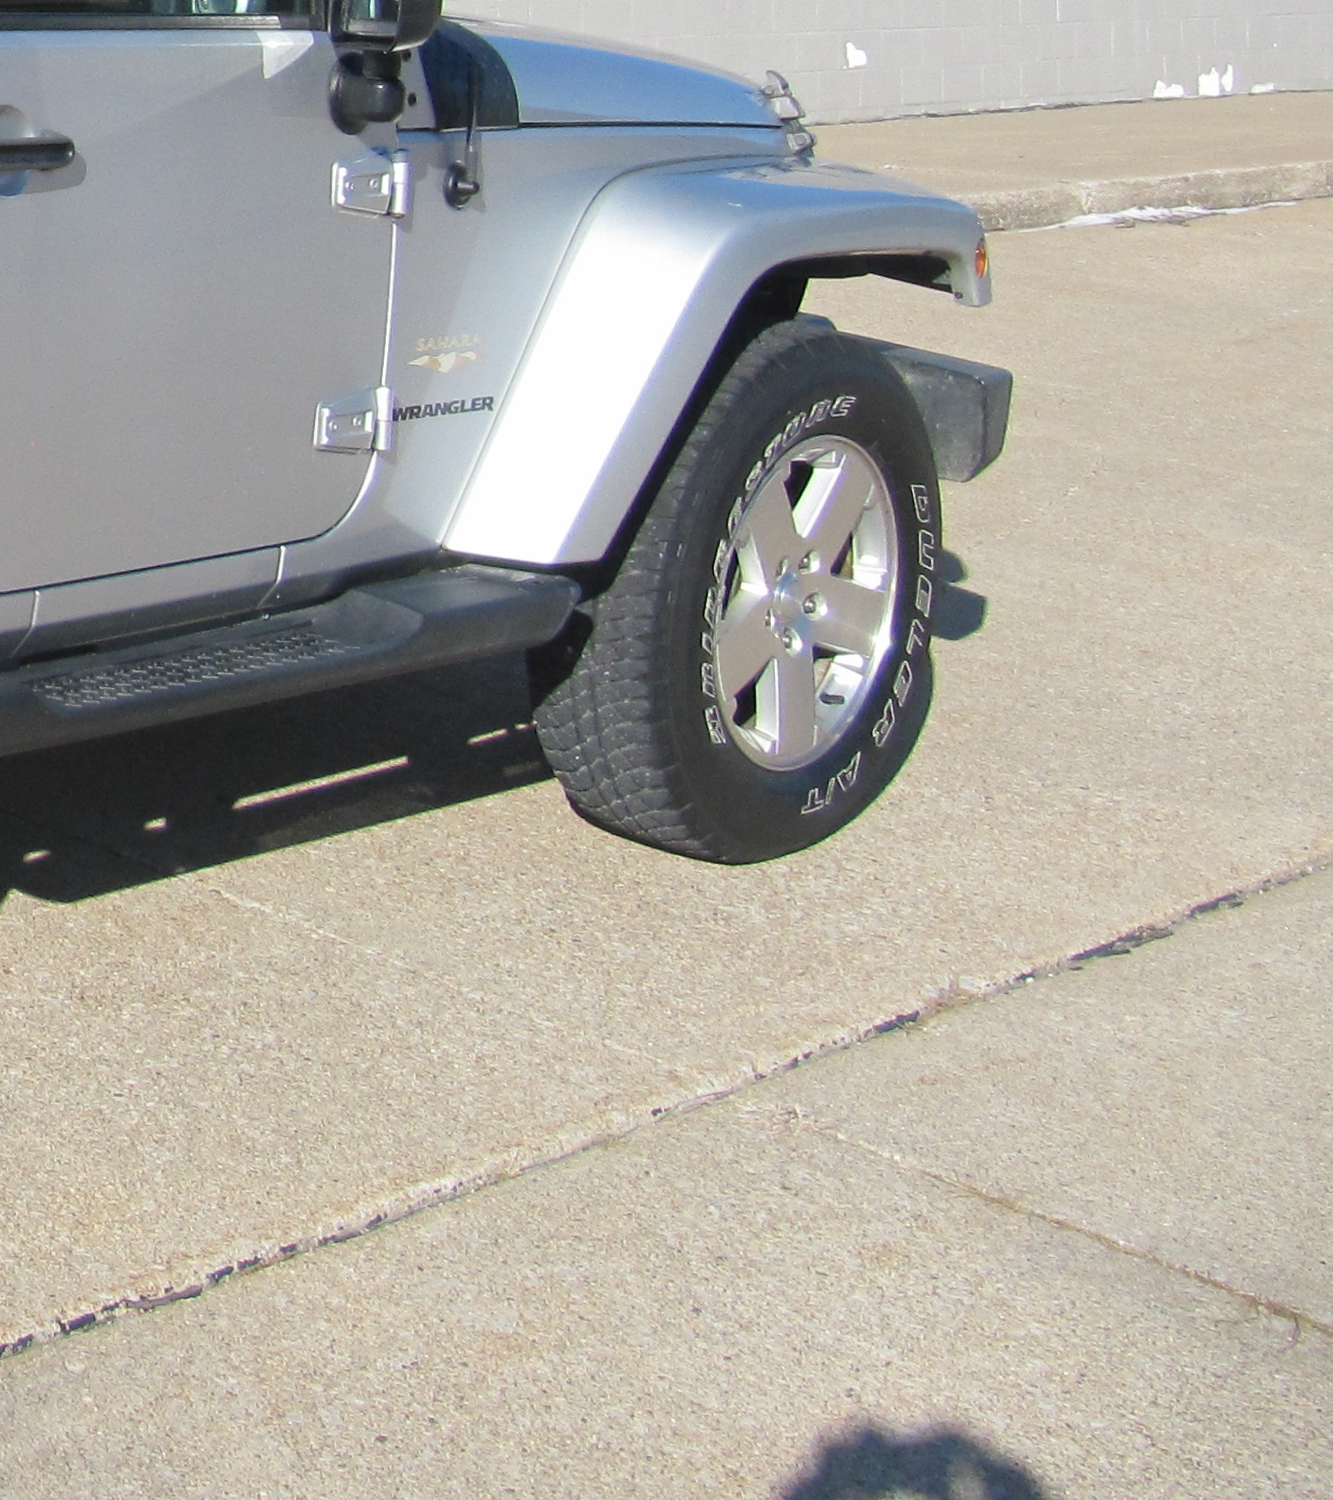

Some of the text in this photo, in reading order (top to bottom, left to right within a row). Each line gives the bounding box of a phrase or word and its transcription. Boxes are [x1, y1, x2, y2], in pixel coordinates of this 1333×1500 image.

[392, 396, 494, 421] WRANGLER
[801, 484, 935, 814] DUELER A/T
